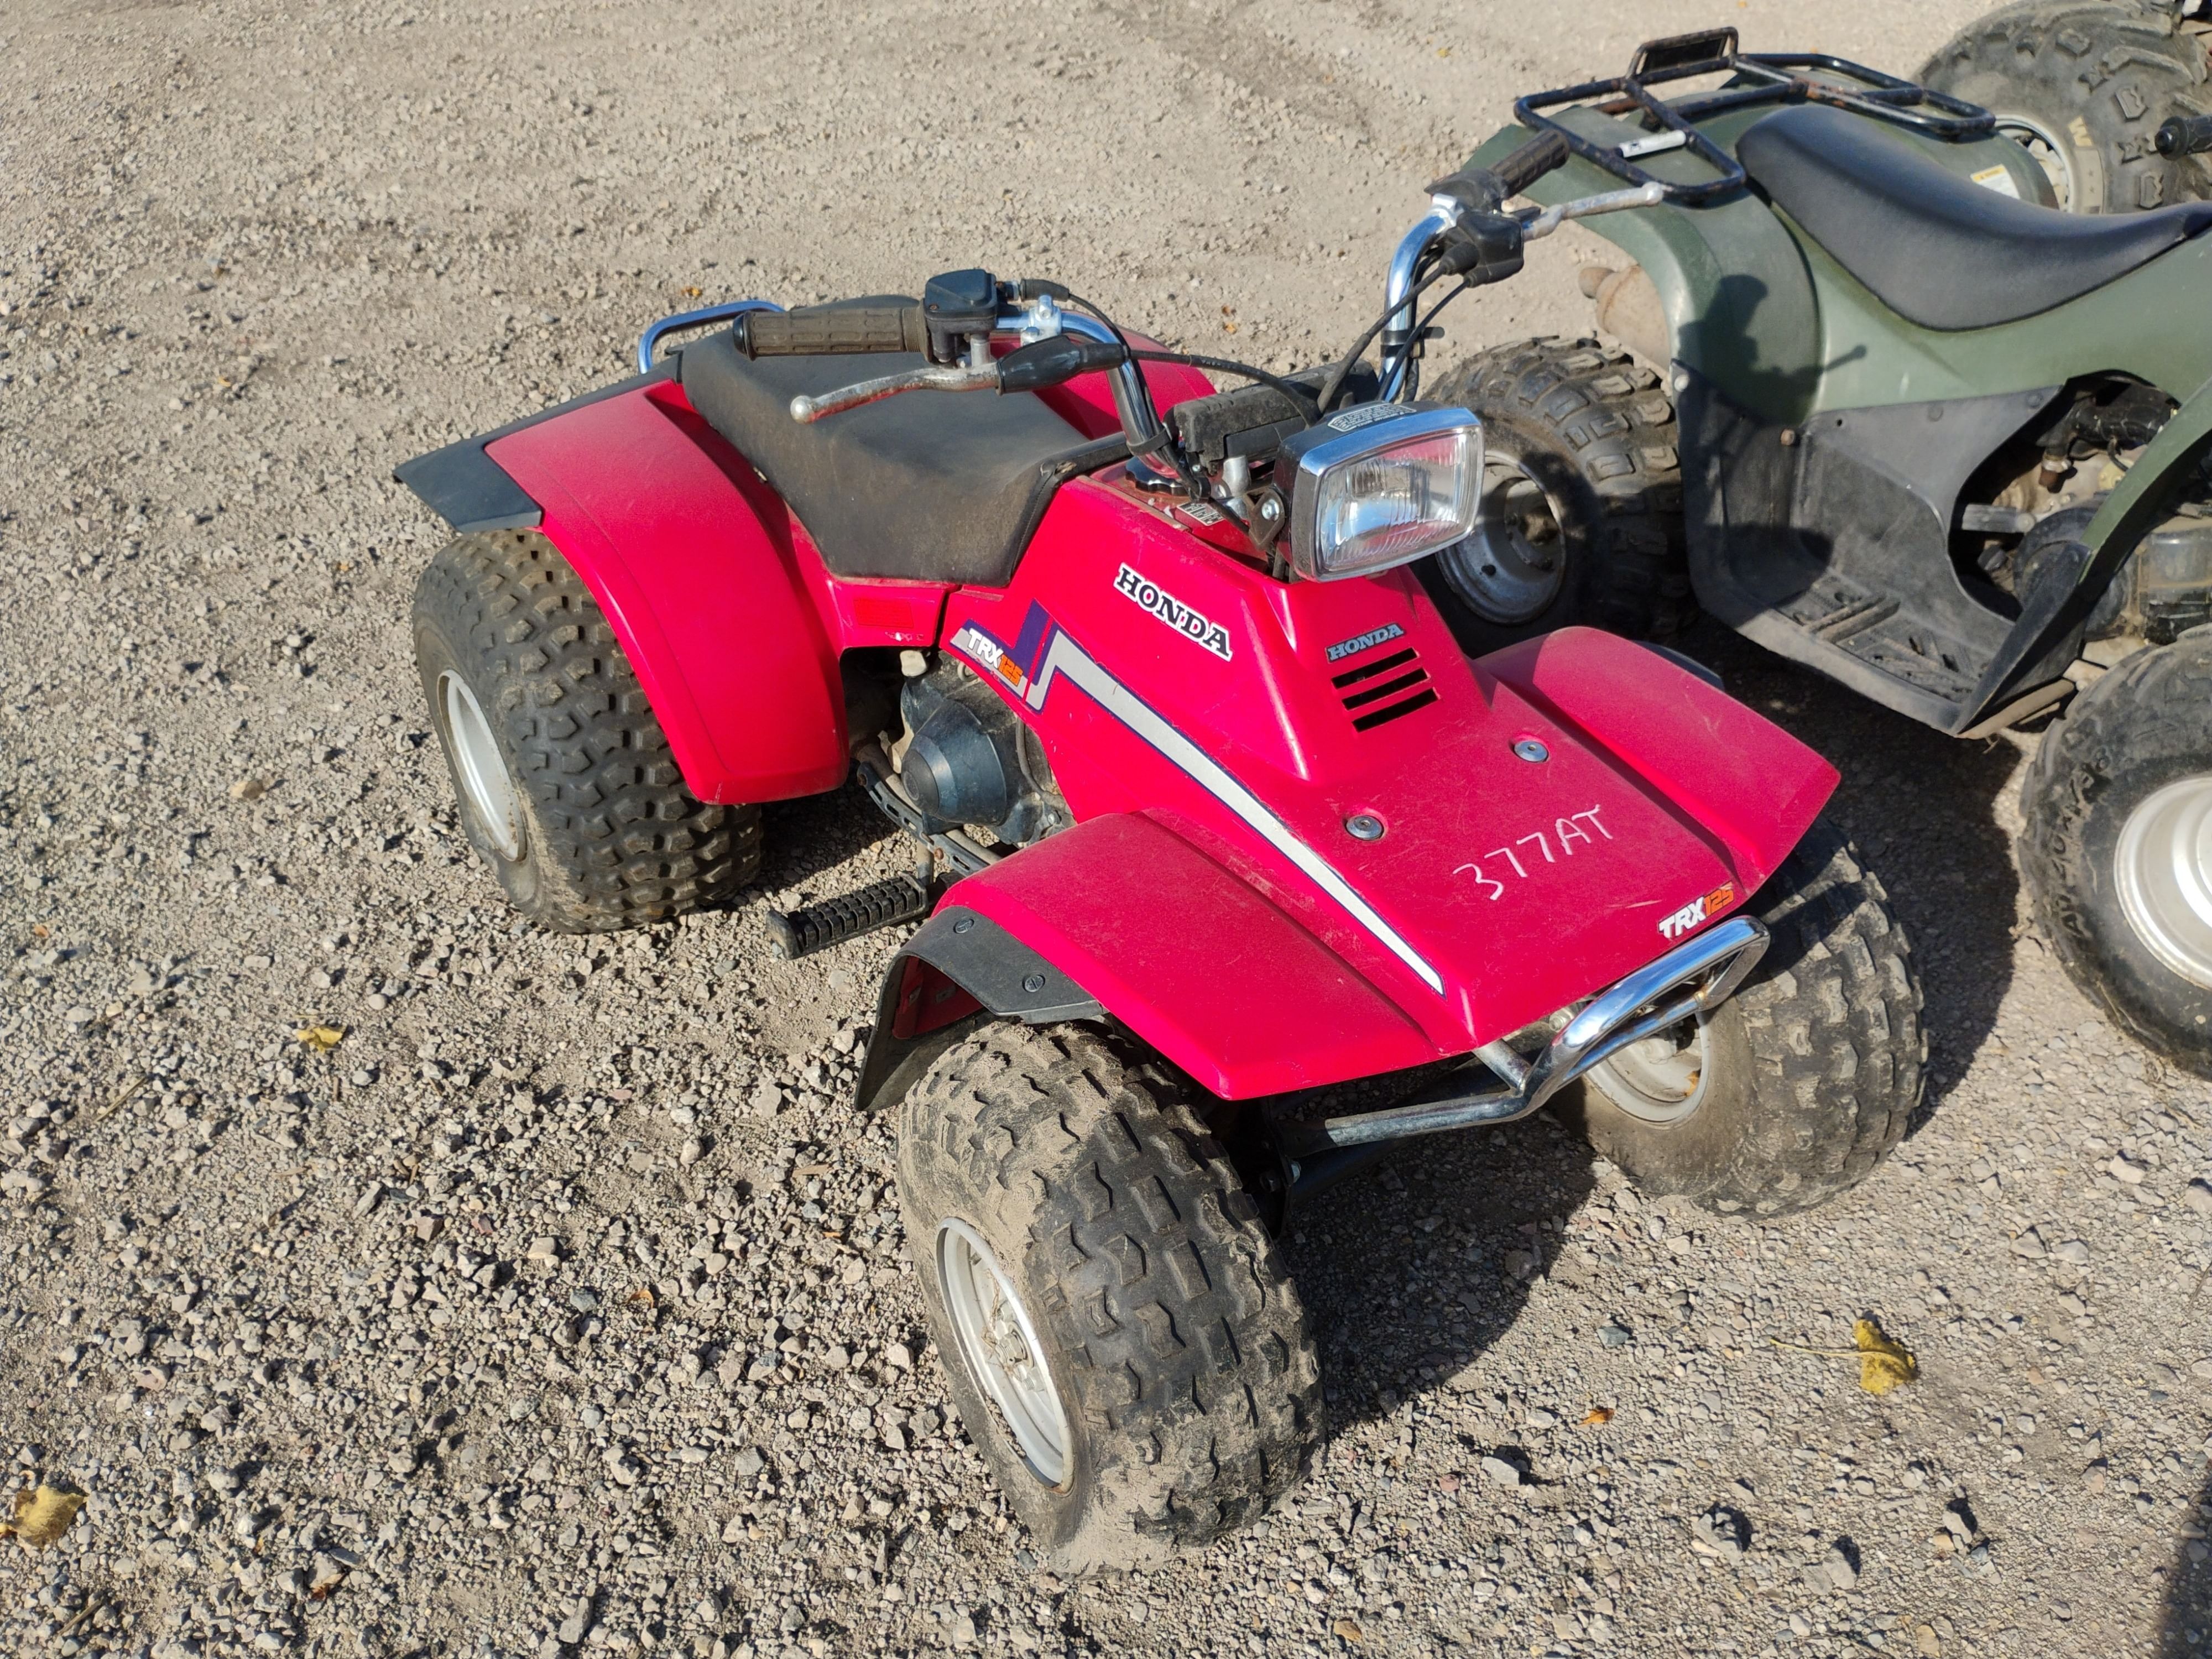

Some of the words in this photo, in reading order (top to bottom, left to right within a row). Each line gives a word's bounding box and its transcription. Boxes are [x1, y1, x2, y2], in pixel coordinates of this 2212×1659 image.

[1115, 564, 1231, 660] HONDA
[1328, 623, 1404, 661] HONDA
[1452, 804, 1613, 900] 377AT
[1659, 884, 1734, 939] TRX125
